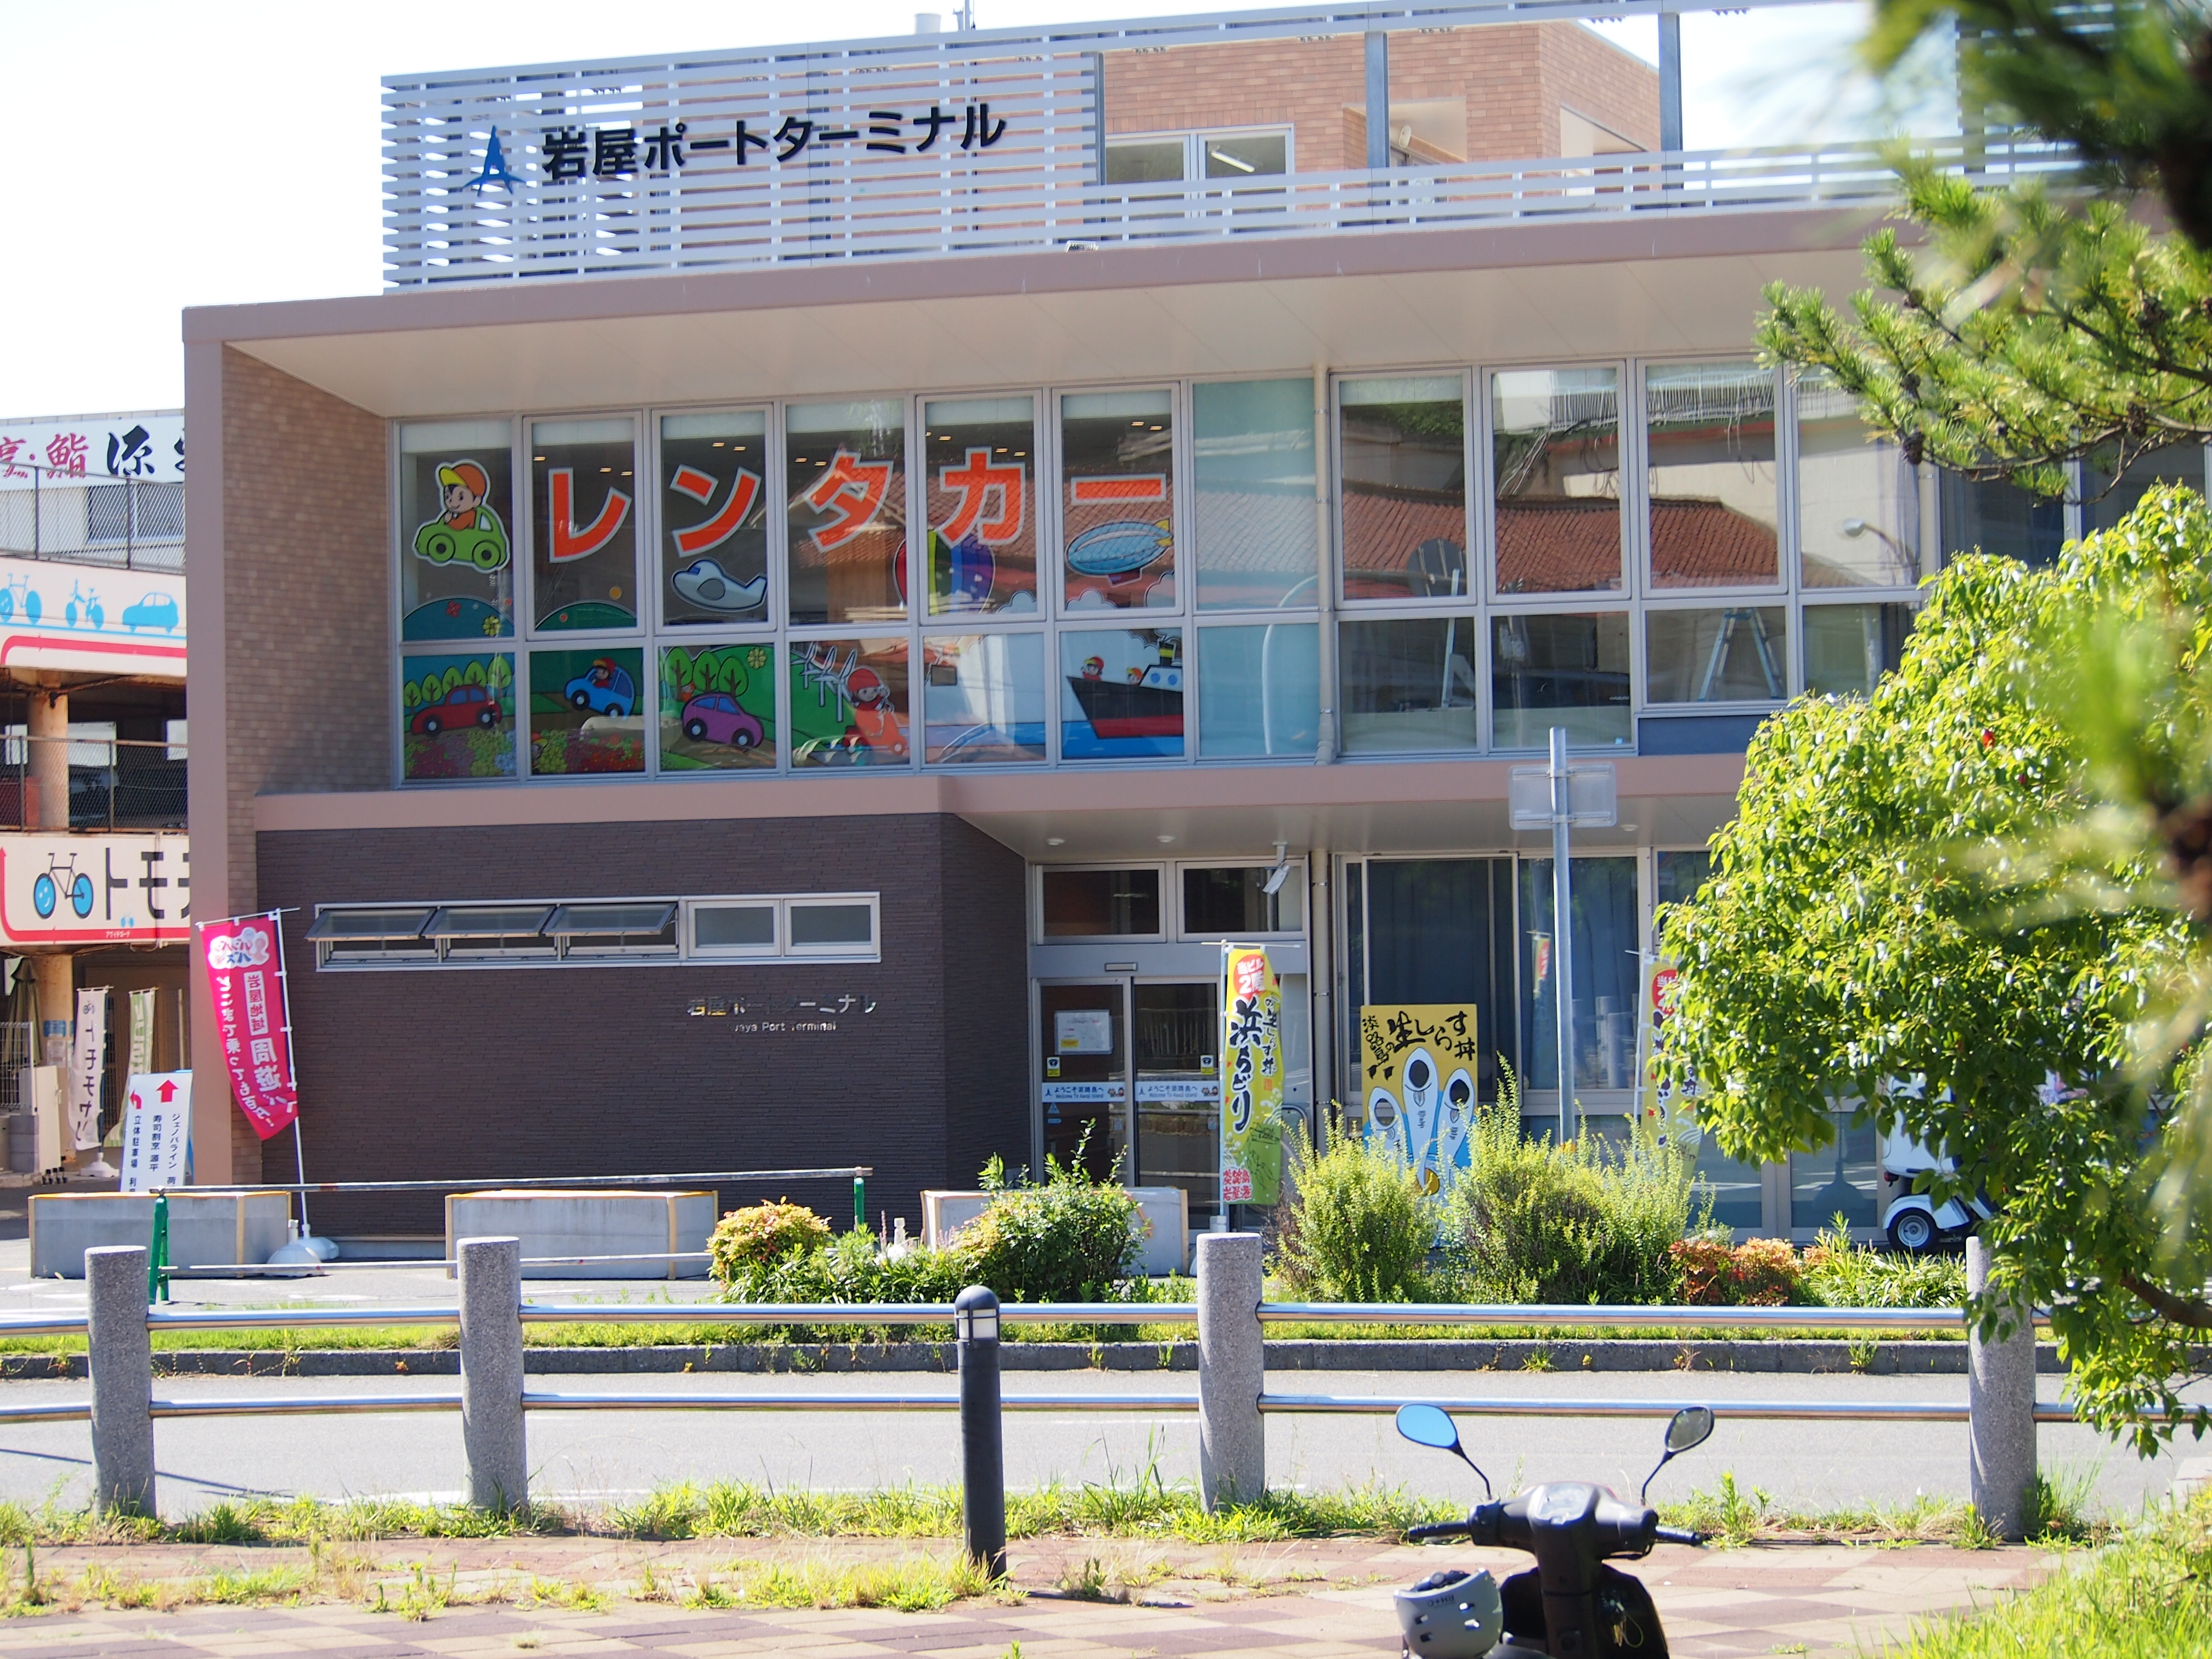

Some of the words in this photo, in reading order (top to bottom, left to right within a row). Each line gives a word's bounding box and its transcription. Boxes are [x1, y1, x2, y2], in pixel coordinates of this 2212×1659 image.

[542, 102, 1006, 180] 岩屋ポートターミナル
[106, 424, 185, 478] 源
[549, 445, 1167, 563] レンタカー
[762, 1022, 786, 1032] Port
[131, 1115, 142, 1169] 立体駐車場
[151, 1115, 162, 1150] 寿司割烹
[168, 1113, 181, 1170] ジェノバライン
[149, 1154, 159, 1172] 源平
